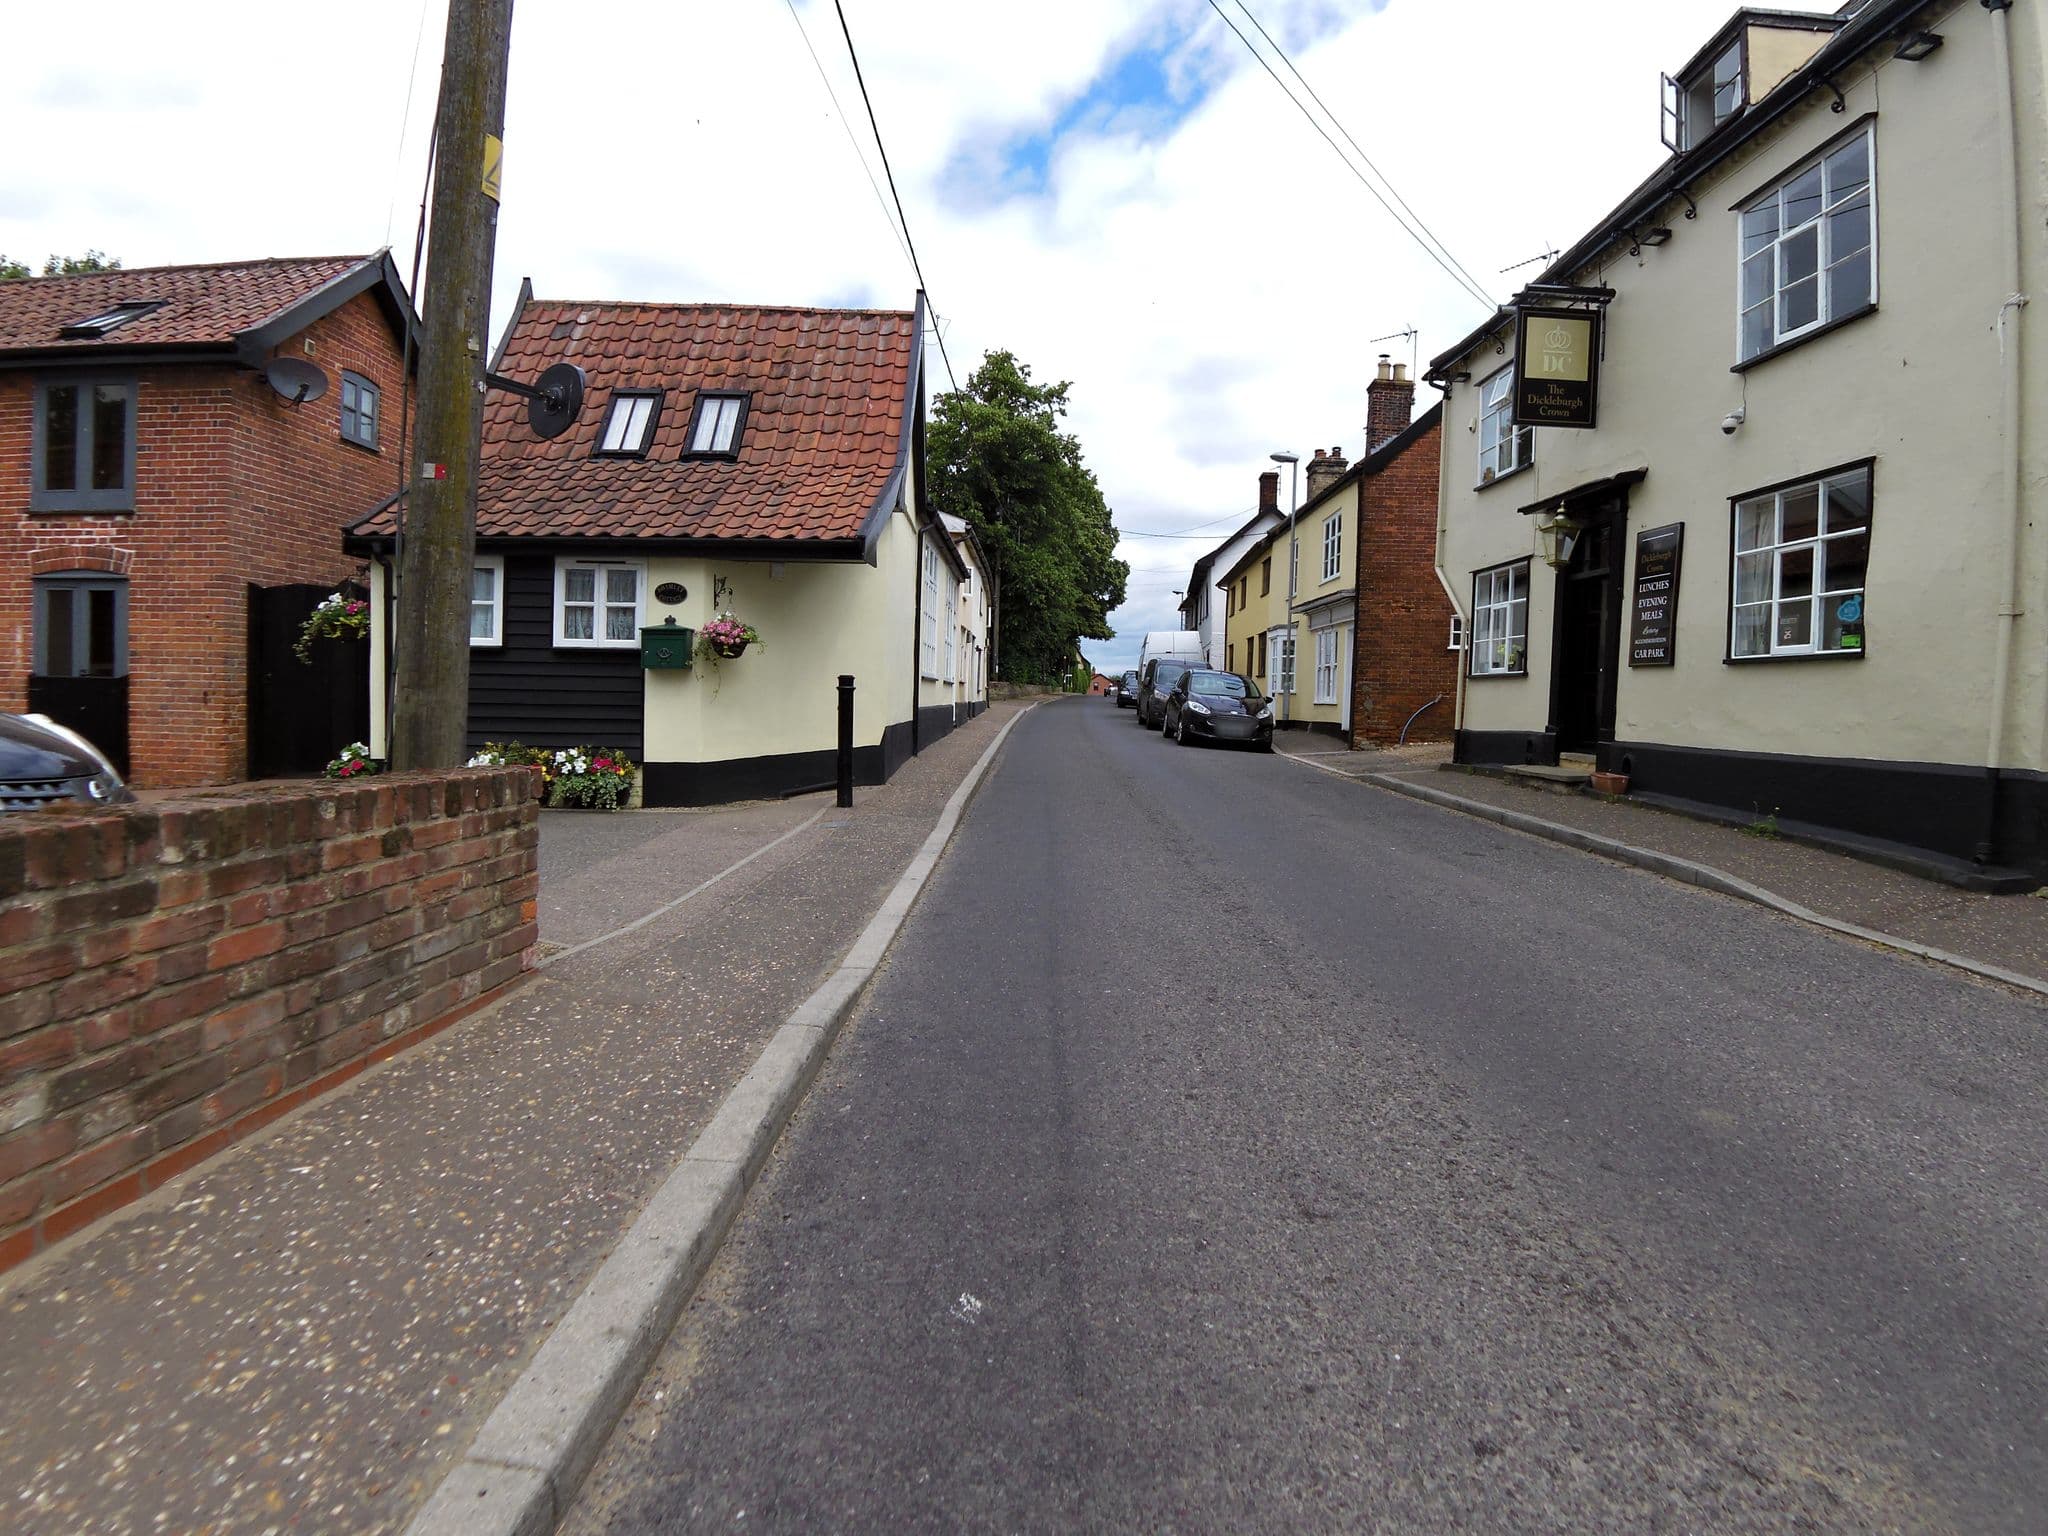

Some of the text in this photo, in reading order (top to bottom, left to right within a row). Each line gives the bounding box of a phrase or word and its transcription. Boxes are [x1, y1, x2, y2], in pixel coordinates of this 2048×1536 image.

[1543, 354, 1572, 373] DC
[1548, 384, 1565, 395] The
[1527, 394, 1583, 409] Dickleburgh
[1540, 406, 1570, 417] Crown
[1639, 580, 1670, 593] LUNCHES
[1638, 596, 1668, 608] EVENING
[1641, 610, 1663, 620] MEALS
[1634, 648, 1665, 659] CAR PARK
